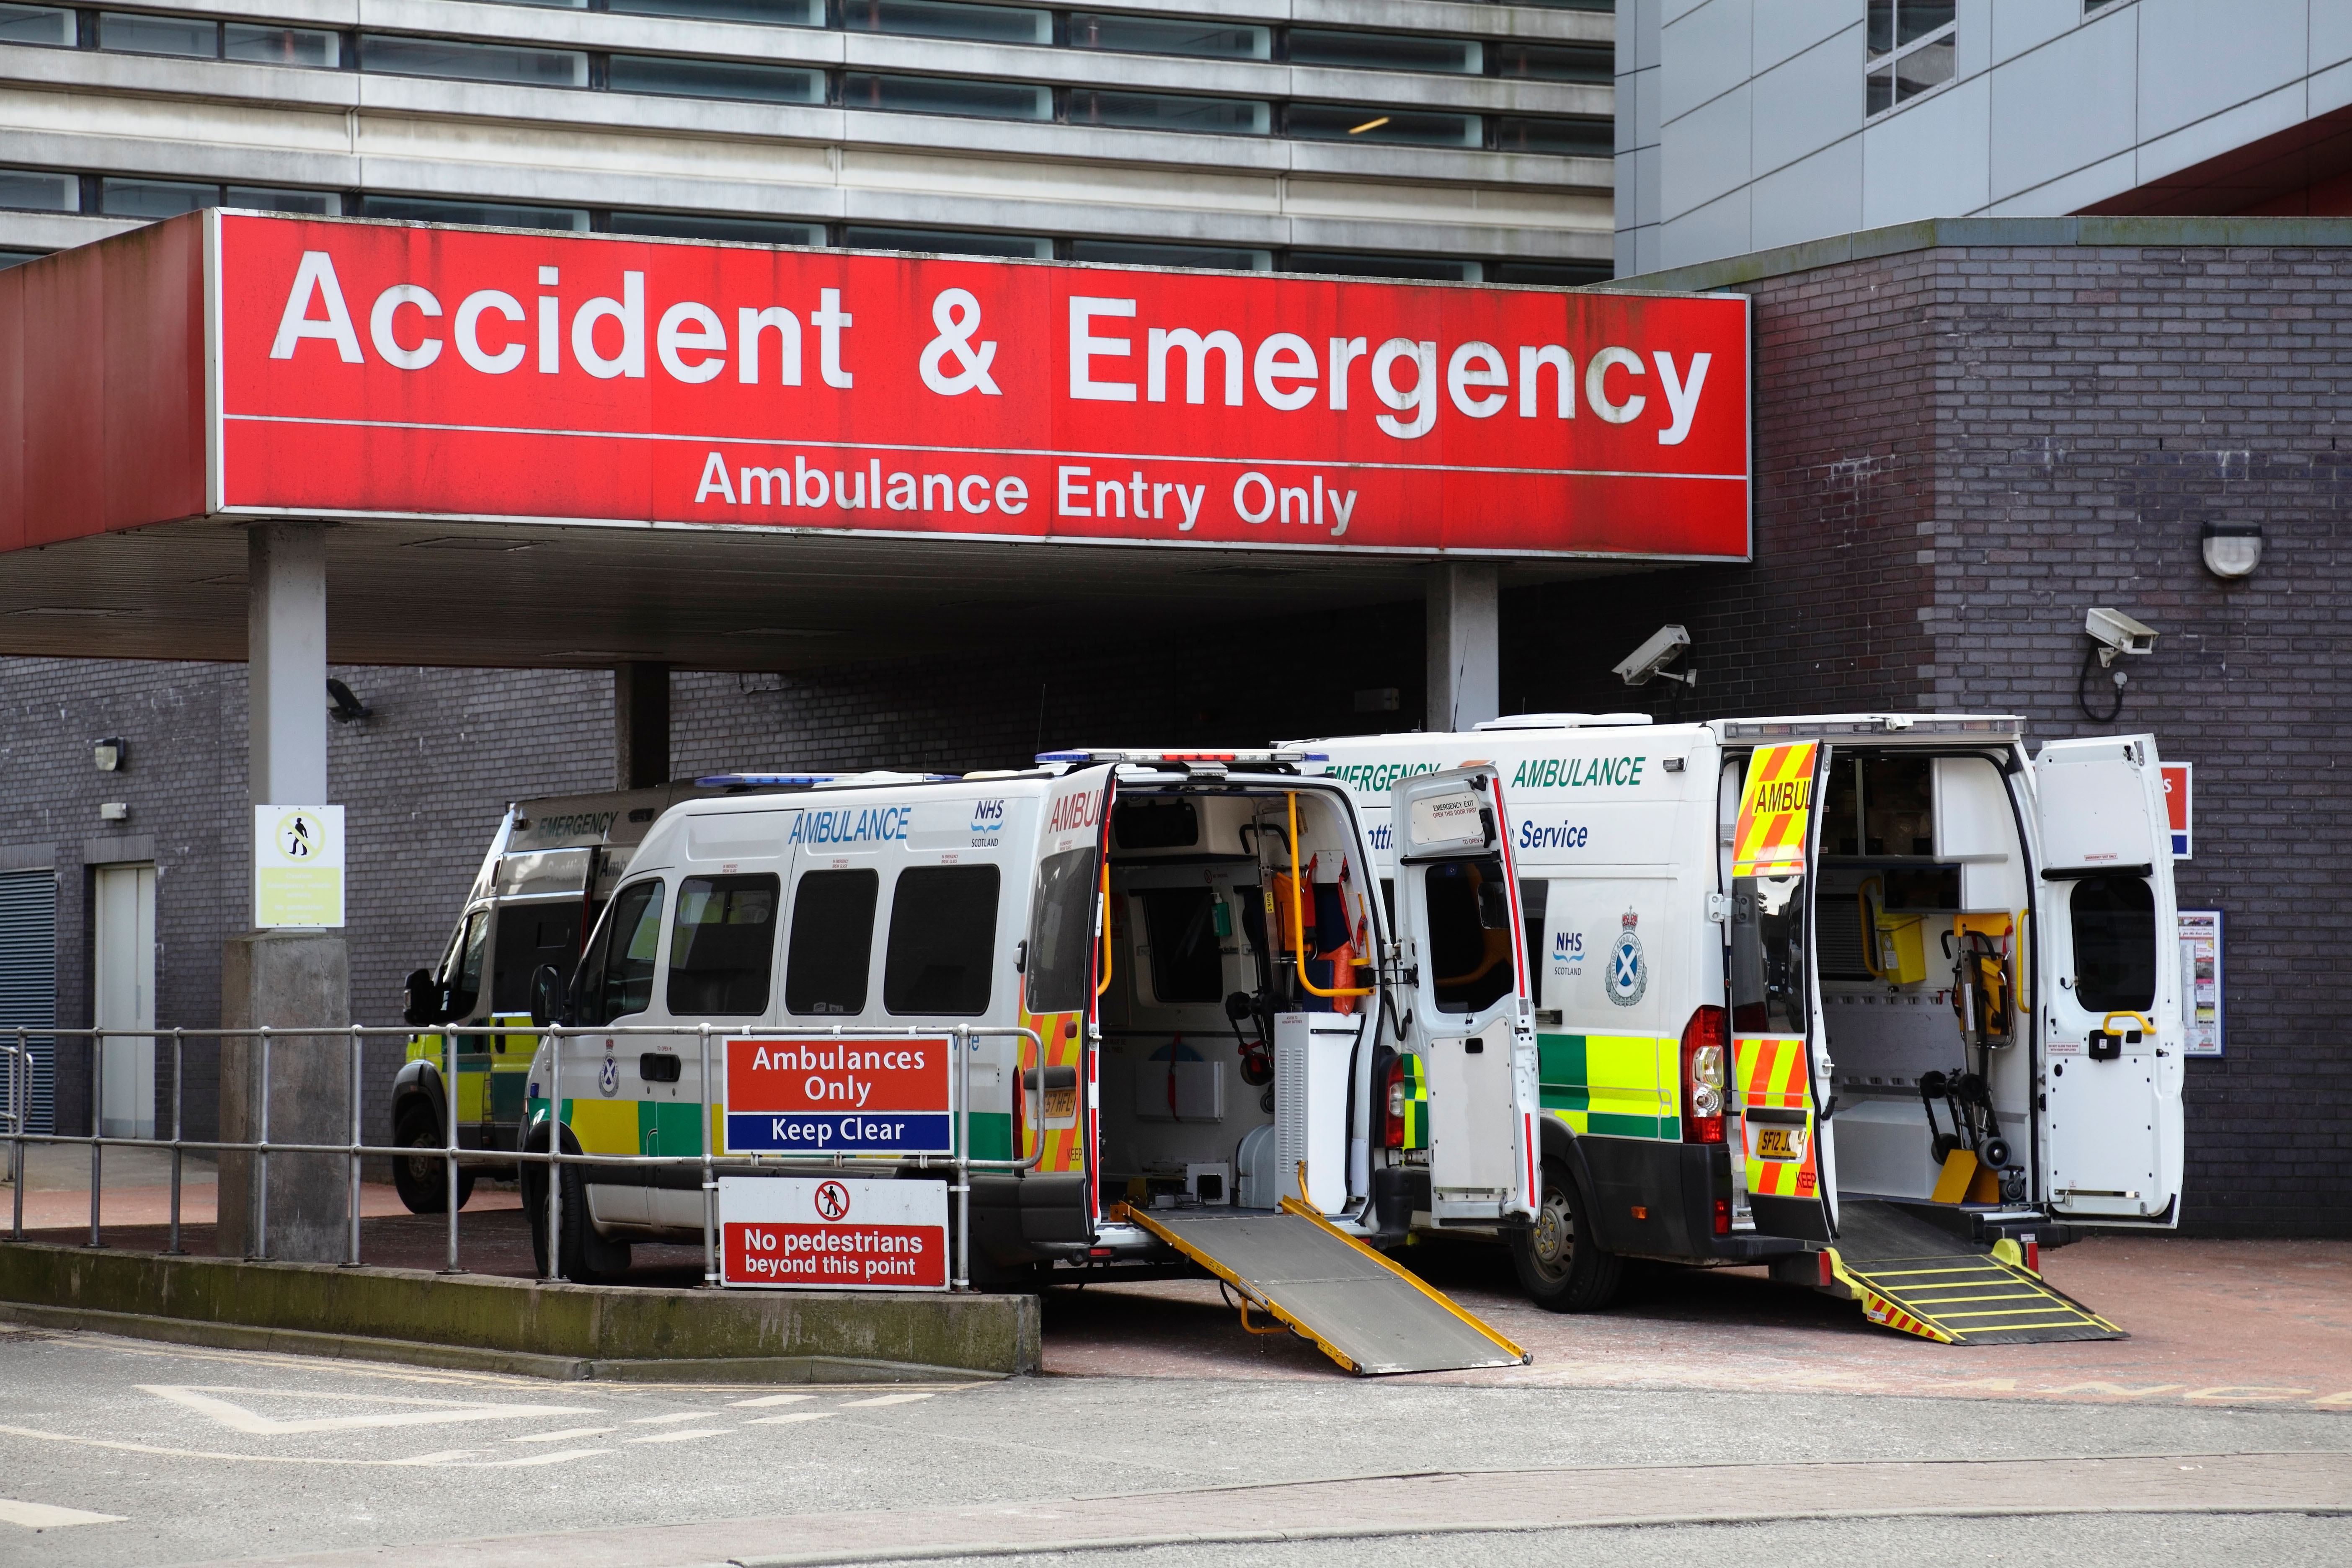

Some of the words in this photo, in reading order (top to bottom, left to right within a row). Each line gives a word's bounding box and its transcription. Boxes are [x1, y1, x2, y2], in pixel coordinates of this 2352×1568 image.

[269, 250, 853, 389] Accident
[919, 288, 1003, 396] &
[1069, 296, 1712, 446] Emergency
[694, 451, 1029, 514] Ambulance
[1058, 465, 1206, 531] Entry
[1233, 472, 1358, 536] Only
[1511, 756, 1647, 788] AMBULANCE
[975, 799, 1004, 819] NHS
[1433, 801, 1462, 812] EMERGENCY
[538, 811, 619, 839] EMERGENCY
[788, 807, 911, 845] AMBULANCE
[1520, 819, 1588, 849] Service
[971, 838, 999, 847] SCOTLAND
[1556, 932, 1583, 952] NHS
[1554, 966, 1582, 976] SCOTLAND
[752, 1045, 924, 1070] Ambulances
[805, 1075, 871, 1107] Only
[772, 1118, 832, 1147] Keep
[840, 1117, 905, 1140] Clear
[1762, 1131, 1781, 1151] SF12
[1067, 1148, 1082, 1161] KEEP
[1795, 1171, 1816, 1189] KEEP
[745, 1229, 776, 1250] No
[785, 1230, 923, 1256] pedestrians
[746, 1255, 816, 1277] beyond
[822, 1255, 859, 1274] this
[865, 1257, 915, 1279] point
